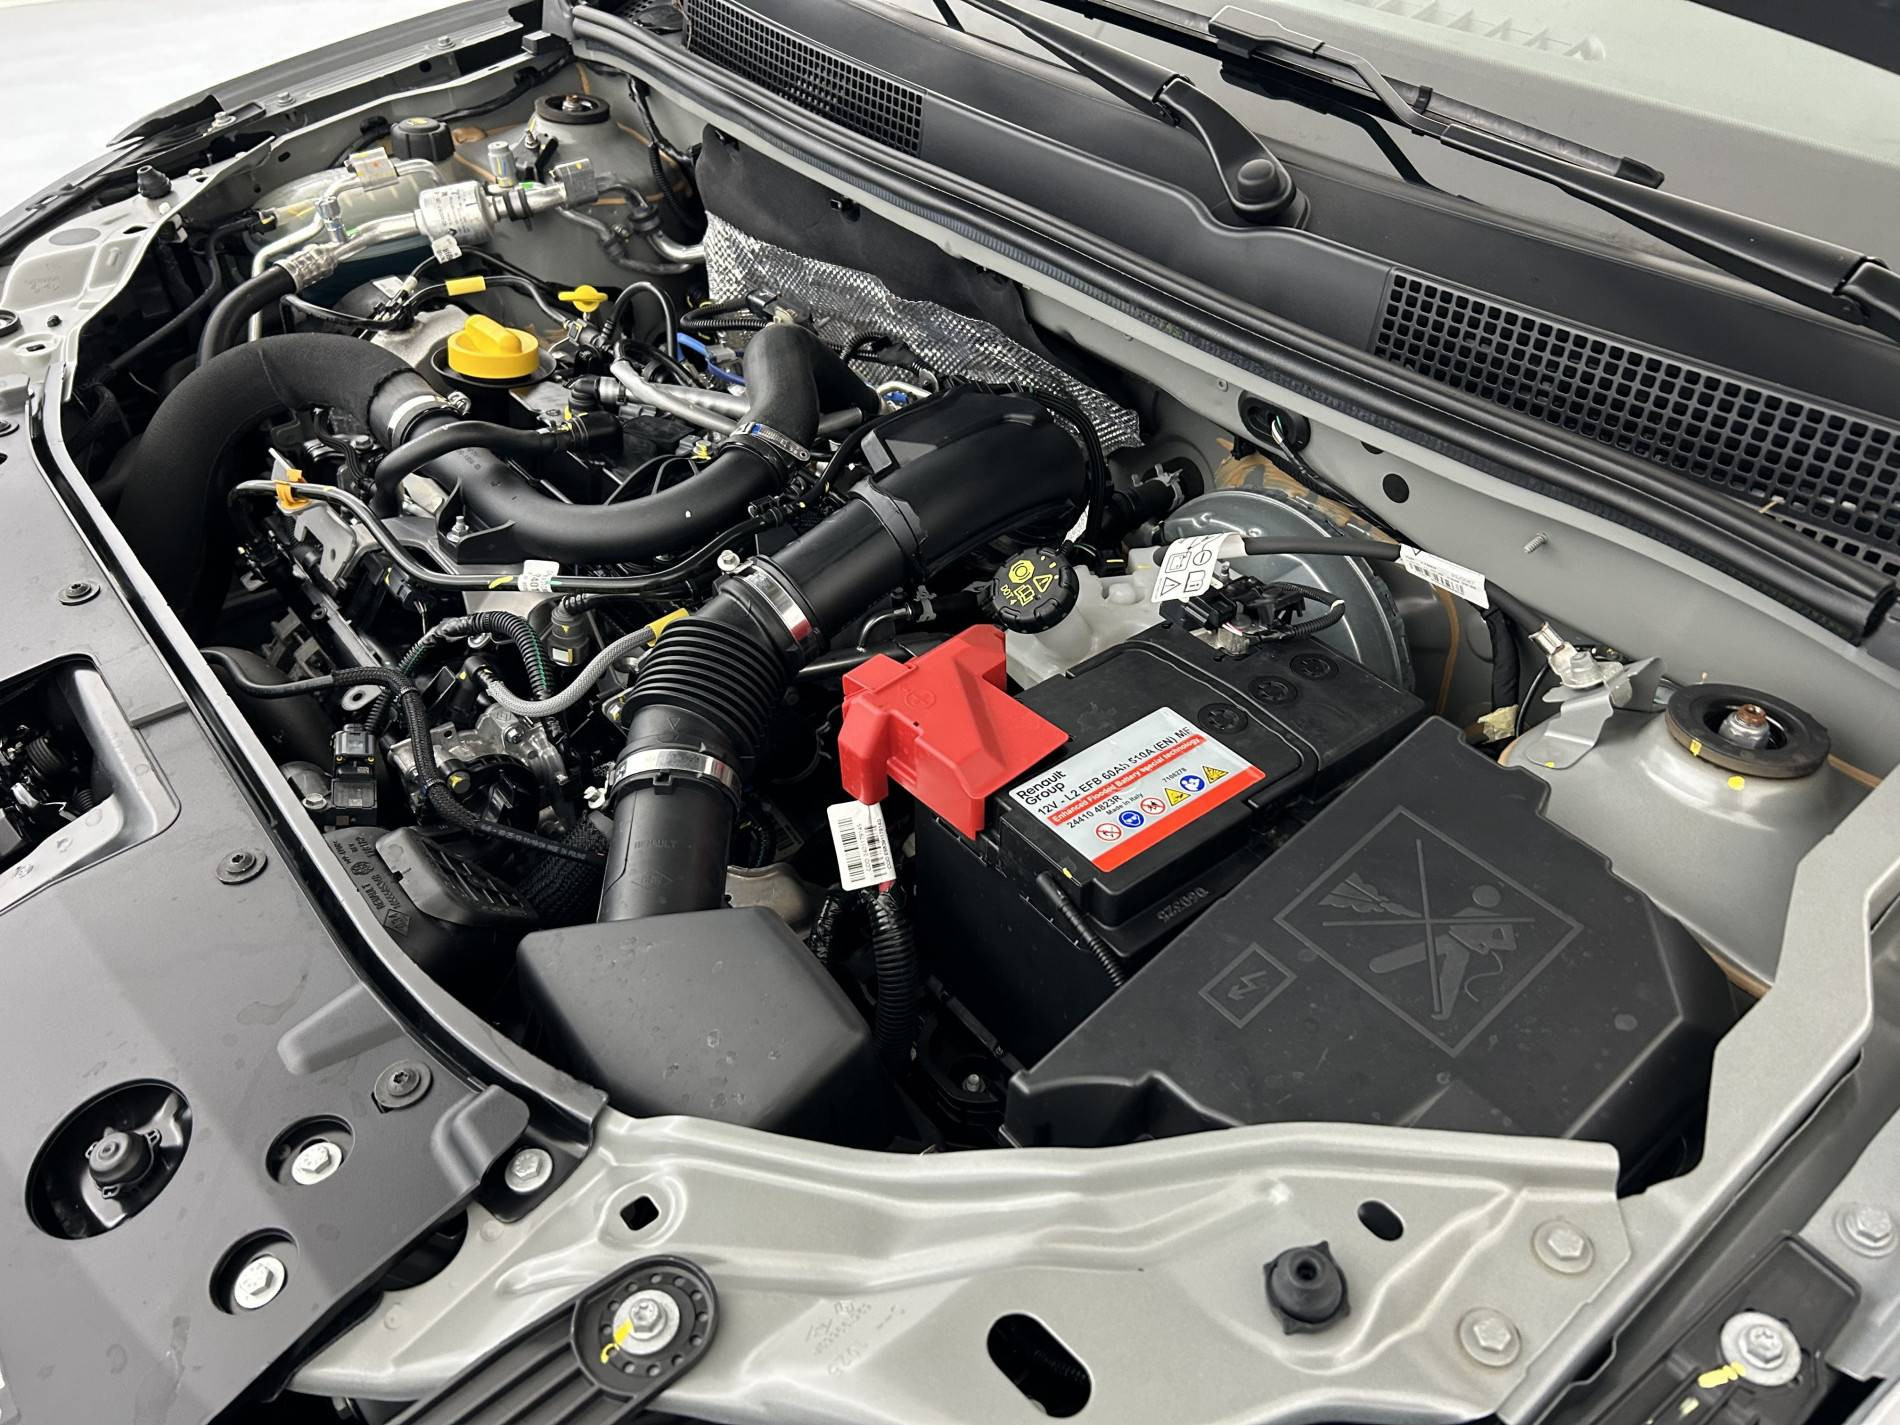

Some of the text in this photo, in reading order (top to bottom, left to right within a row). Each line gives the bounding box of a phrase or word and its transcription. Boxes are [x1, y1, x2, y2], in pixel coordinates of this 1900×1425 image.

[1001, 584, 1015, 600] DOT
[1038, 801, 1058, 815] 12V
[1064, 790, 1081, 801] L2
[1078, 777, 1102, 792] EFB
[1102, 764, 1130, 780] 60Ah
[1128, 749, 1155, 764] 510A
[1153, 737, 1178, 751] (EN)
[1174, 727, 1190, 738] MF
[1016, 771, 1066, 799] Renault
[1023, 780, 1065, 805] Group
[1052, 799, 1089, 822] Enhanced
[1114, 771, 1141, 787] Battery
[1106, 805, 1124, 815] Made
[1129, 793, 1144, 802] Italy
[1067, 811, 1094, 828] 24410
